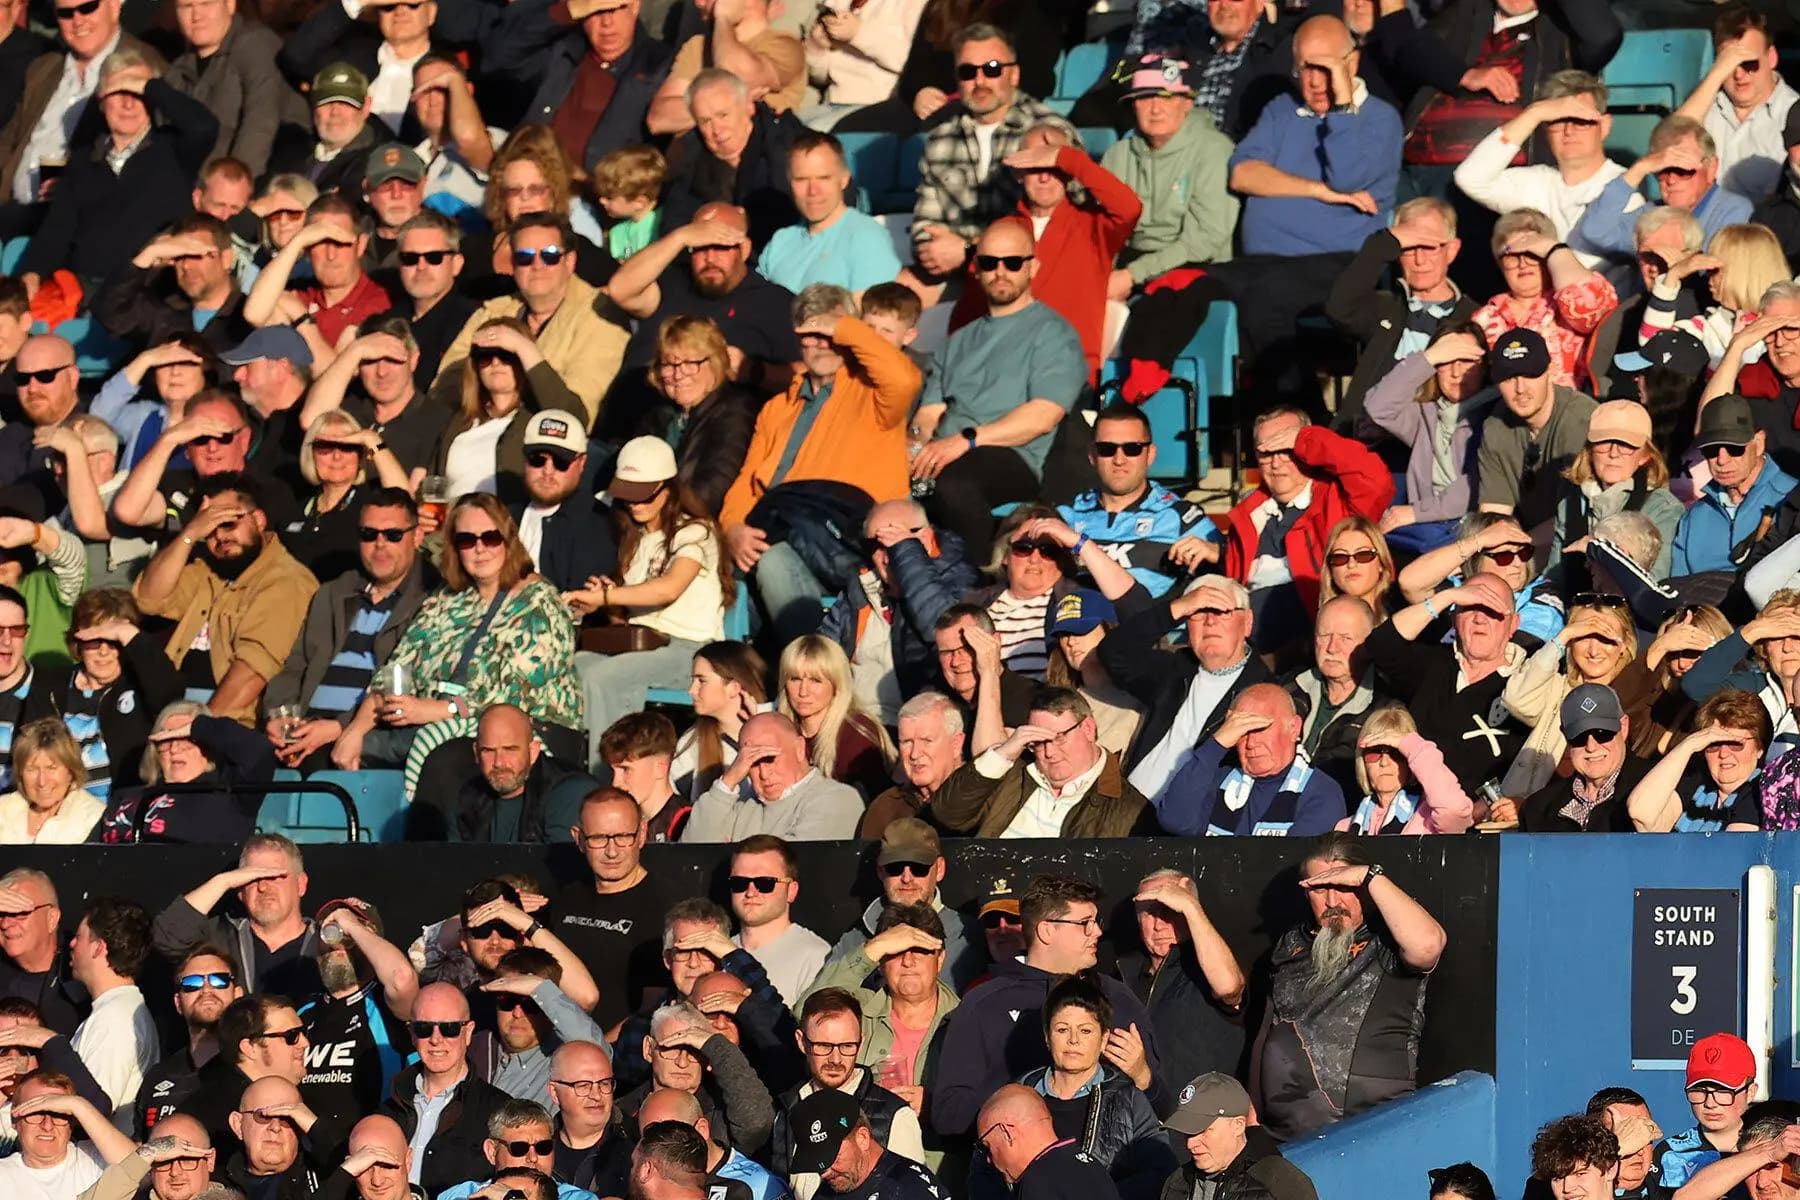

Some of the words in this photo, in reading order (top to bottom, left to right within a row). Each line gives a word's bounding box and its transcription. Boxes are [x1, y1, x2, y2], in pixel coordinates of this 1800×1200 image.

[1654, 906, 1716, 923] SOUTH
[1654, 929, 1715, 947] STAND
[1670, 965, 1698, 1016] 3
[1672, 1029, 1695, 1046] DE
[303, 1040, 357, 1068] WE
[301, 1069, 352, 1085] enewables
